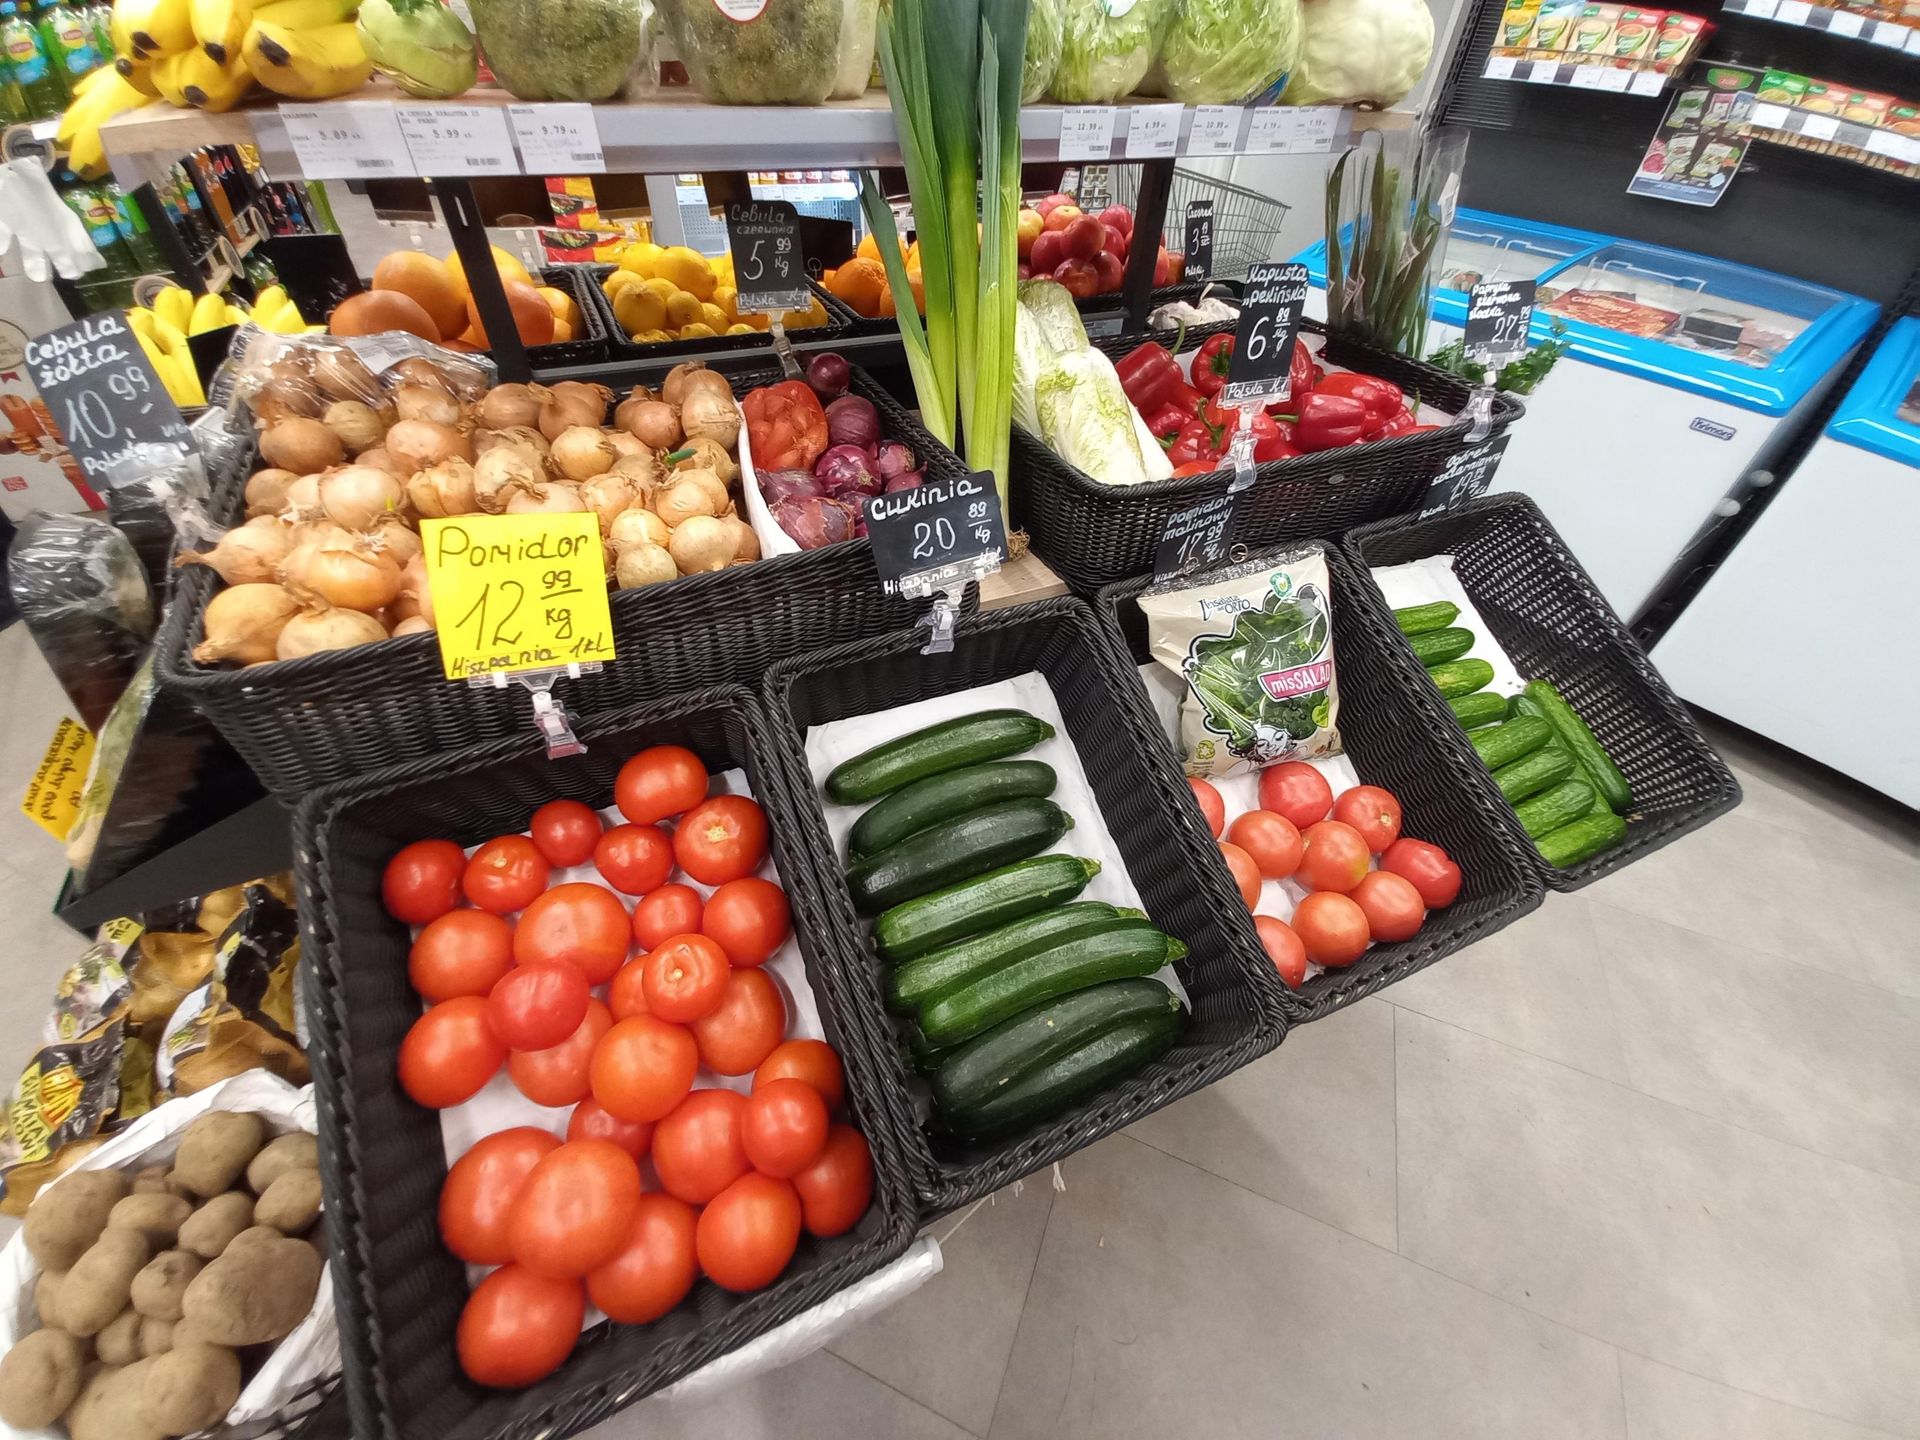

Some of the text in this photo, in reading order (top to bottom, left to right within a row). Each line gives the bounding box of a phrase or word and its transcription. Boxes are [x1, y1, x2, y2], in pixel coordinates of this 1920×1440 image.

[432, 129, 460, 139] 5.99
[731, 204, 786, 224] Cebula
[744, 237, 792, 280] 5 99
[1191, 228, 1200, 256] 3
[1247, 264, 1309, 287] Kapusta
[25, 316, 128, 366] Cebula
[1247, 307, 1291, 360] 6 89
[1491, 314, 1519, 344] 27
[40, 344, 131, 389] żółta
[65, 366, 150, 448] 10 99
[1227, 382, 1264, 399] Polska
[871, 480, 983, 520] Cukinia
[913, 517, 956, 559] 20
[968, 501, 987, 518] 89
[1176, 522, 1224, 564] 17 99
[455, 569, 572, 651] 12 99
[1271, 663, 1331, 693] misSALAD
